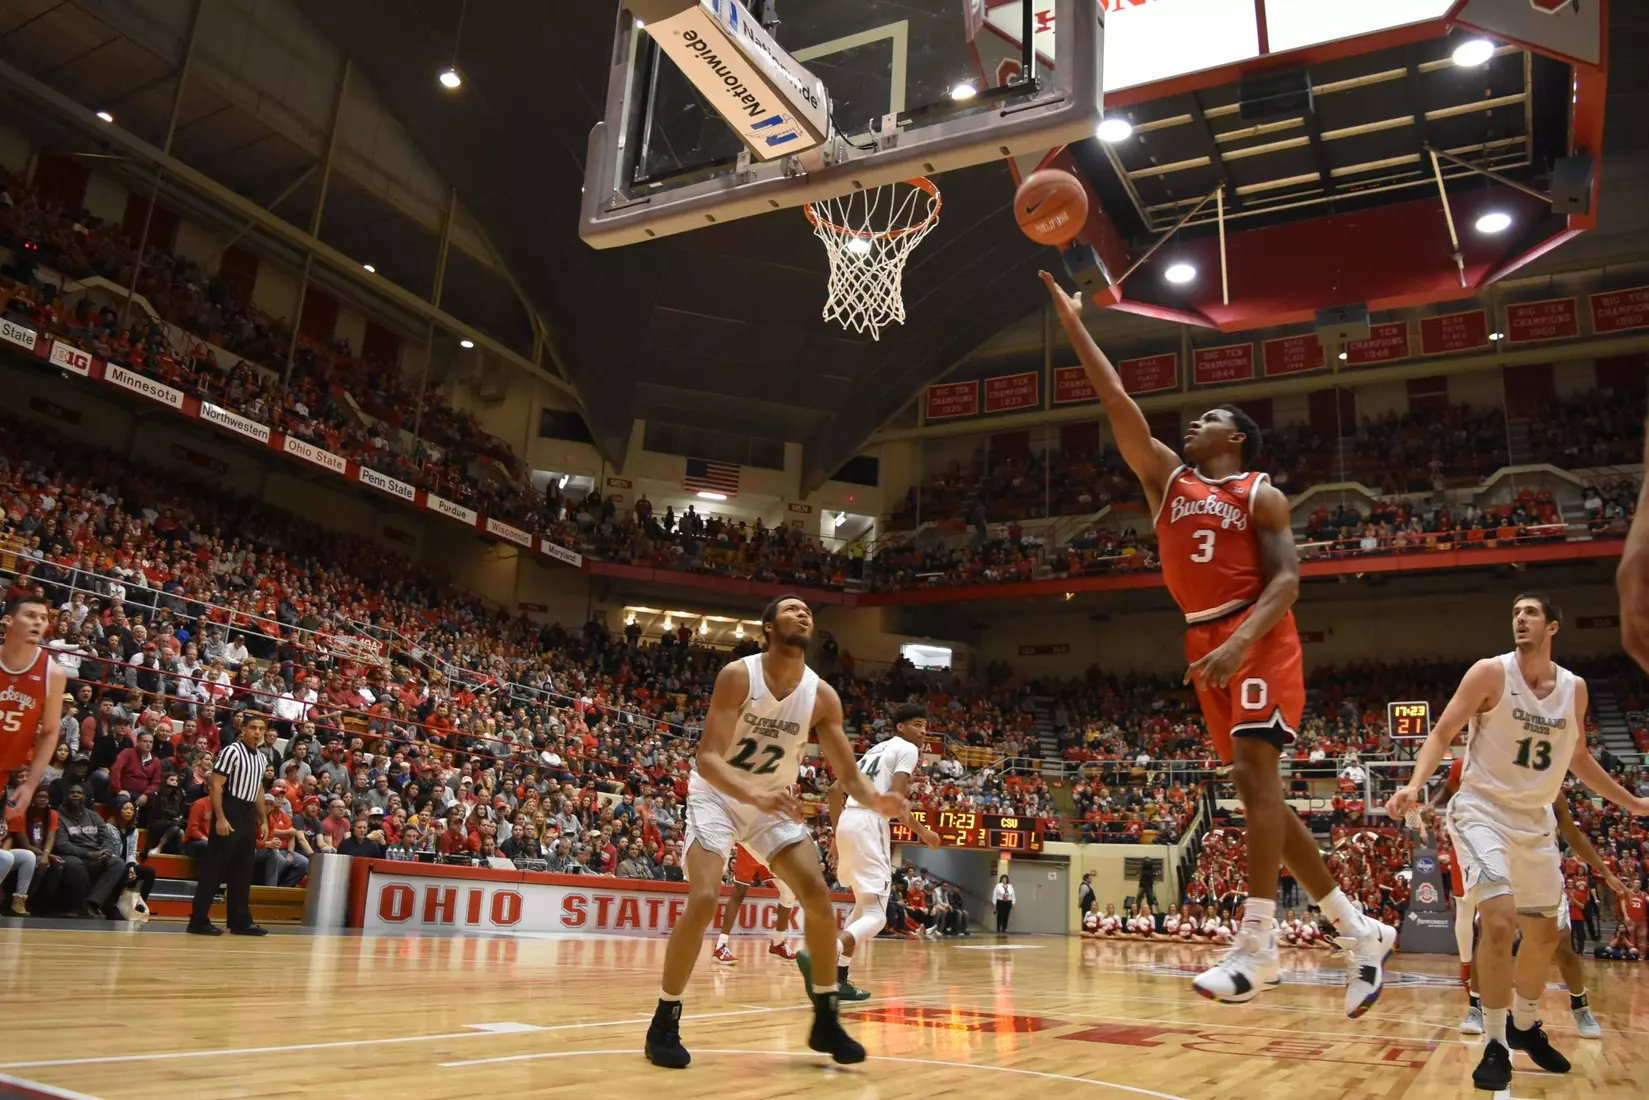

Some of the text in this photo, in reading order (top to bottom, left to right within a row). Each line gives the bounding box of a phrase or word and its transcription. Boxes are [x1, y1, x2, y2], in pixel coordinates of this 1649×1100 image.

[683, 29, 766, 117] Nationwide
[1602, 297, 1620, 305] BIG
[1517, 304, 1564, 317] BIG TEN
[1513, 313, 1571, 327] CHAMPIONS
[2, 323, 33, 345] State
[1378, 327, 1398, 337] TEN
[1350, 337, 1403, 350] CHAMPIONS
[1203, 349, 1243, 360] BIG TEN
[1198, 357, 1248, 370] CHAMPIONS
[1064, 371, 1078, 379] BIG
[112, 368, 177, 404] Minnesota
[988, 385, 1033, 398] CHAMPIONS
[931, 395, 974, 405] CHAMPIONS
[202, 404, 268, 440] Northwestern
[288, 440, 343, 470] Ohio State
[362, 470, 413, 499] Penn State
[438, 500, 467, 519] Purdue
[1170, 494, 1248, 531] Buckeyes
[491, 520, 529, 544] Wisconsin
[548, 545, 577, 563] Maryland
[1190, 529, 1216, 563] 3
[1395, 705, 1426, 716] 17:23
[1513, 708, 1567, 729] CLEVELAND
[743, 713, 800, 736] CLEVELAND
[1398, 718, 1421, 734] 21
[726, 737, 786, 775] 22
[1512, 737, 1552, 771] 13
[940, 812, 975, 829] 17:23
[1001, 817, 1018, 828] CSU
[893, 825, 912, 841] 44
[957, 830, 966, 845] 2
[978, 829, 985, 839] 3
[999, 832, 1018, 847] 30
[378, 882, 523, 928] OHIO
[561, 892, 684, 932] STATE
